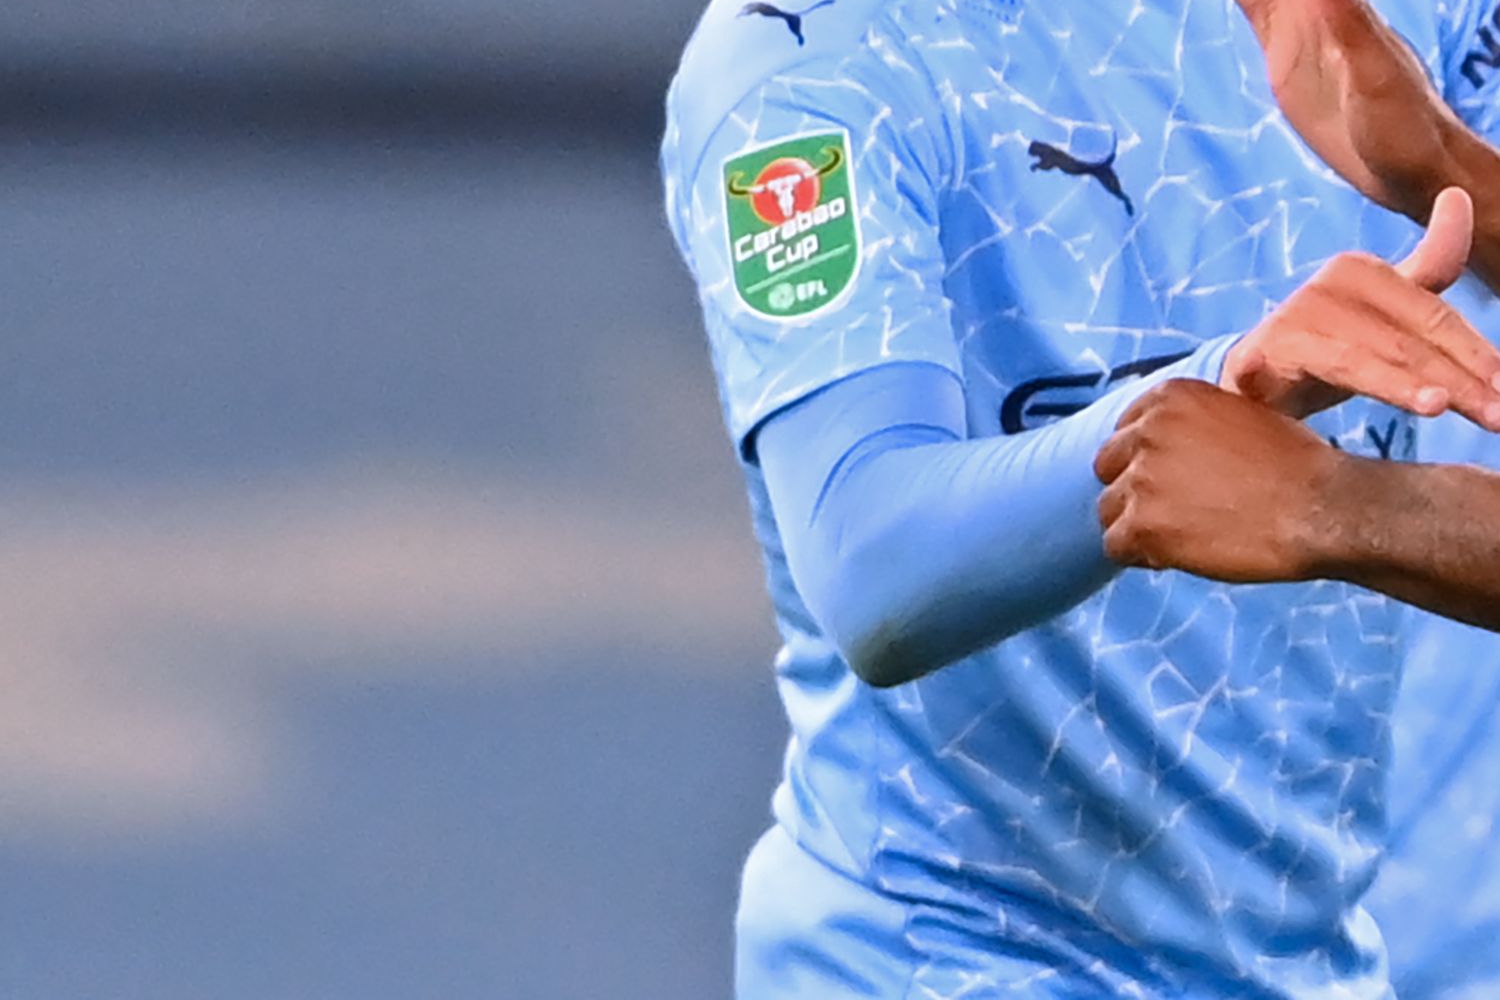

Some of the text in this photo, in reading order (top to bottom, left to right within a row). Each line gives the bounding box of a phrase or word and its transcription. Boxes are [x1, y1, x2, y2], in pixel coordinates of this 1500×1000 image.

[734, 197, 846, 262] Carabao
[765, 234, 819, 273] Cup
[796, 279, 828, 301] EFL
